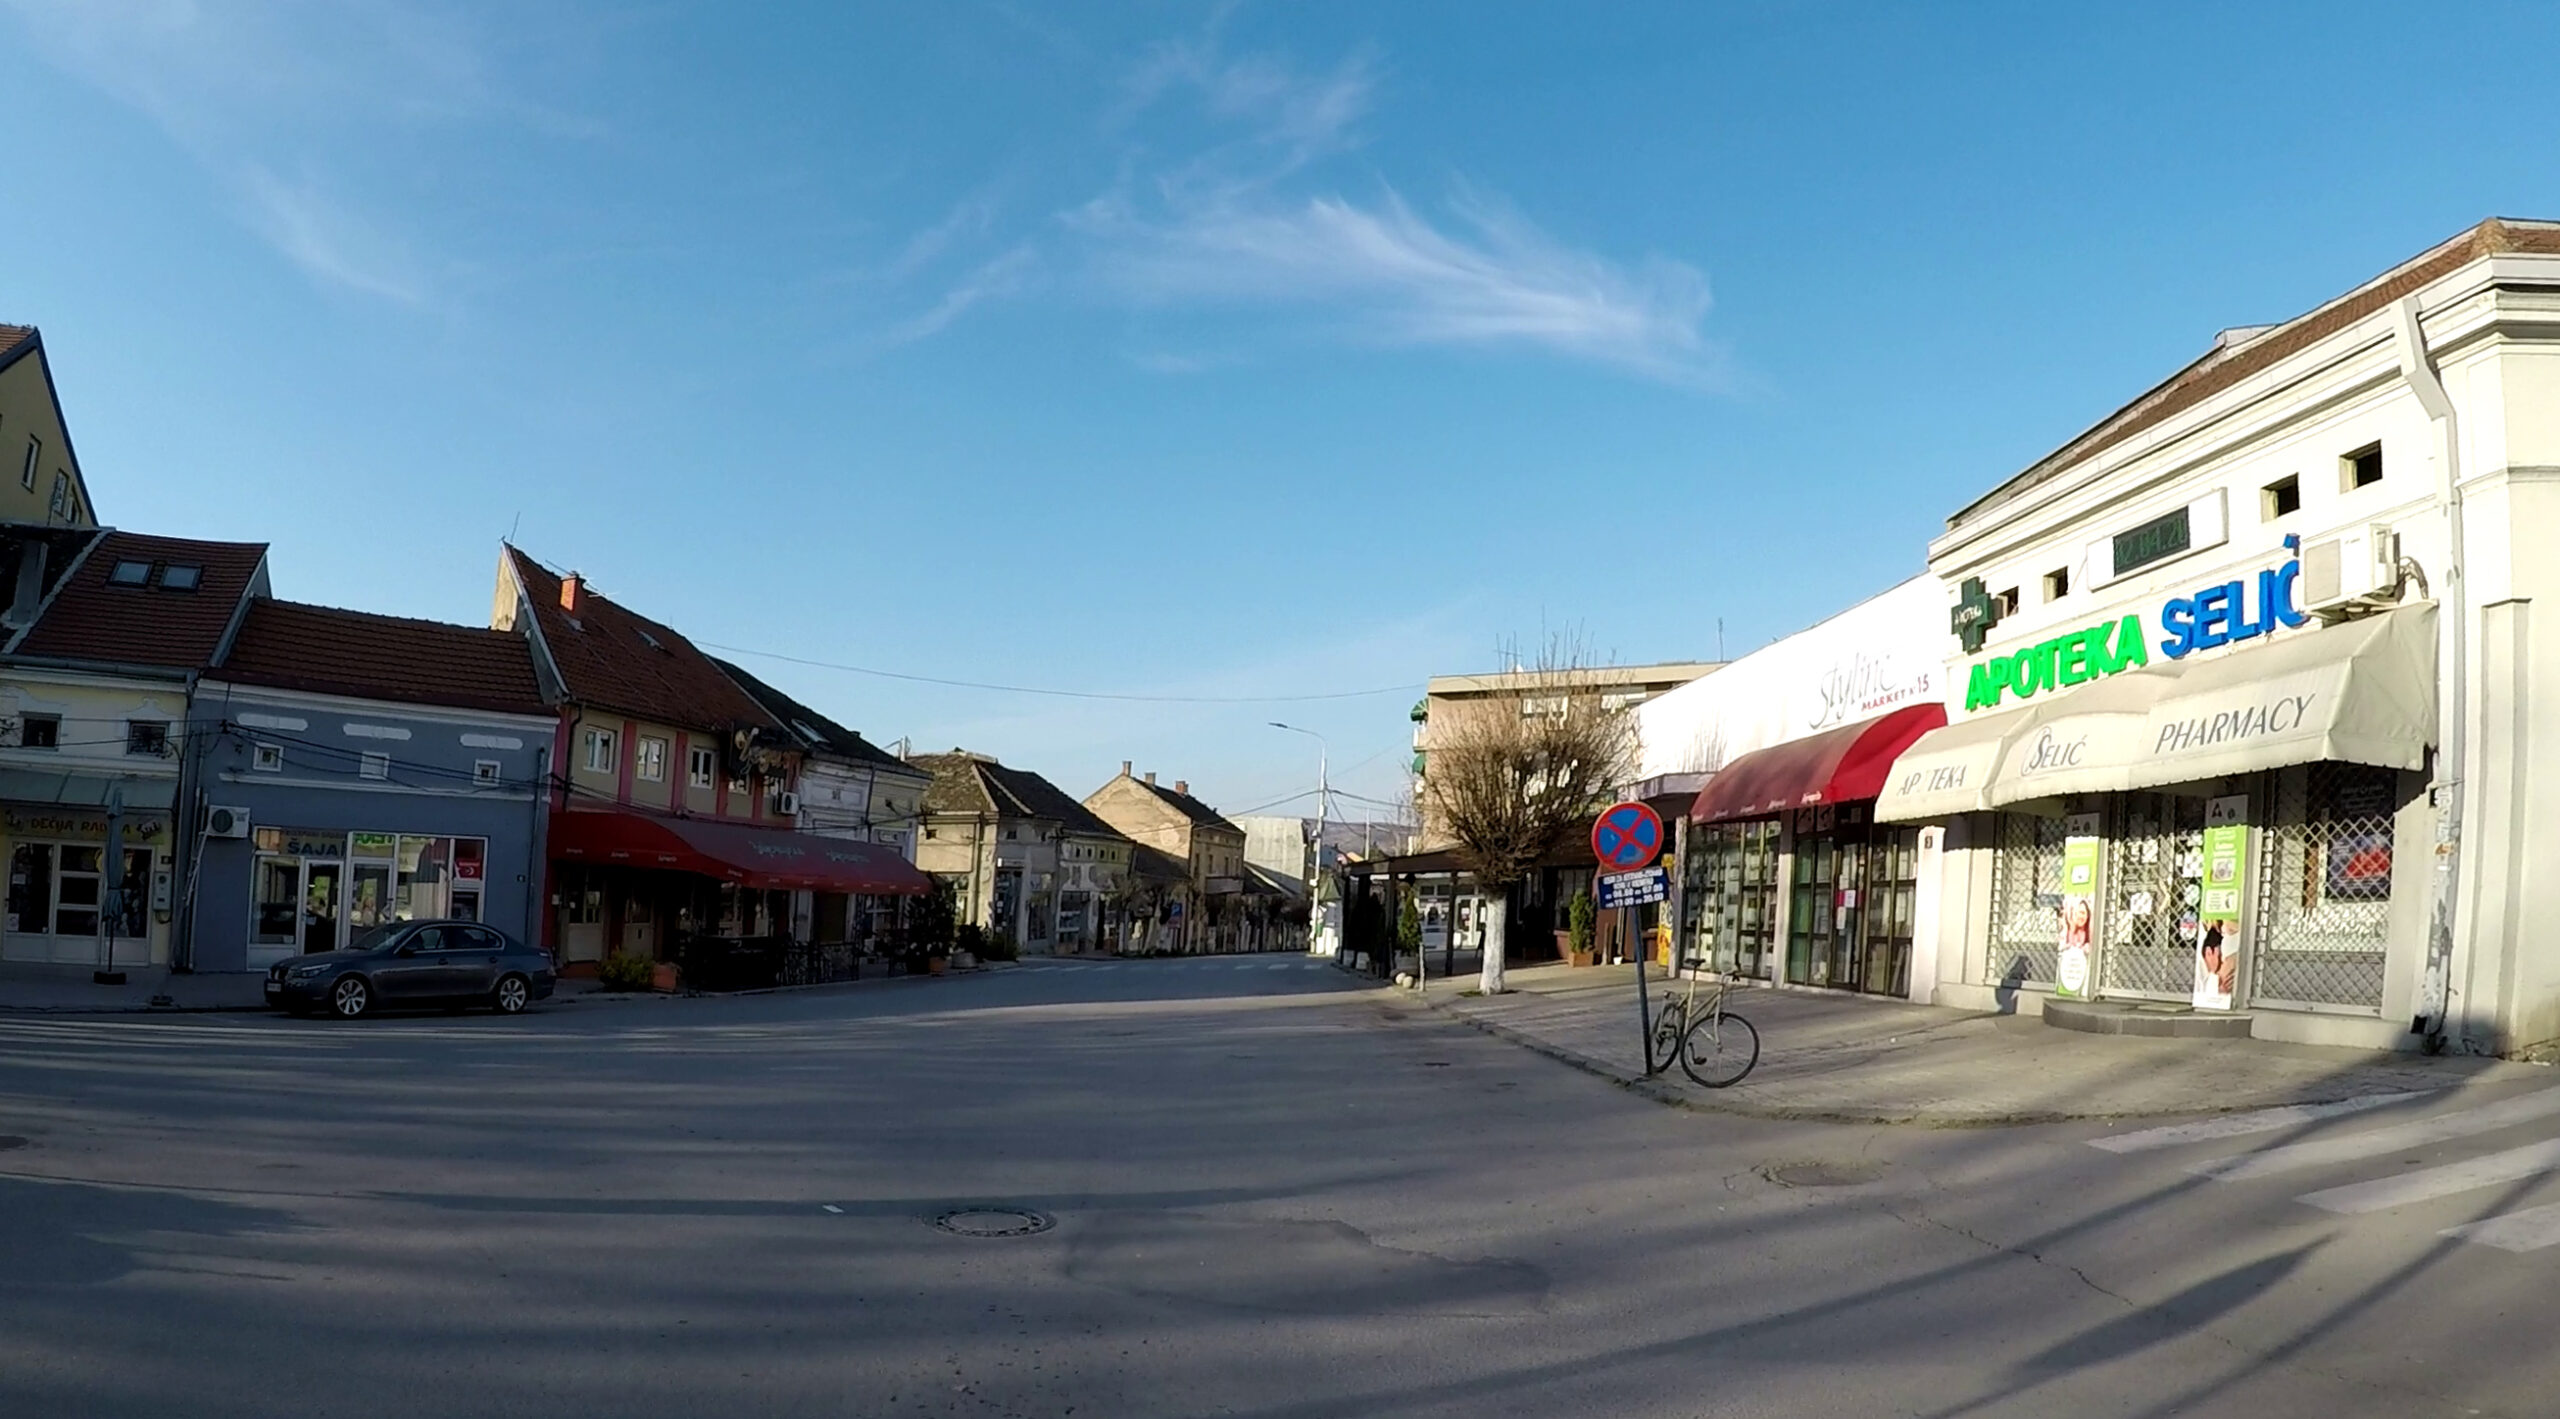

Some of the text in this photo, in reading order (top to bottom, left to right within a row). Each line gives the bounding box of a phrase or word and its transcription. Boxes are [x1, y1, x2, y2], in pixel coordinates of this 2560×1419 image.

[1965, 533, 2310, 712] APOTEKA SELIĆ
[1861, 688, 1905, 711] MARKET
[1917, 673, 1929, 694] 15
[2154, 693, 2316, 754] PHARMACY
[1897, 763, 1968, 796] APTEKA
[81, 822, 131, 834] RADA
